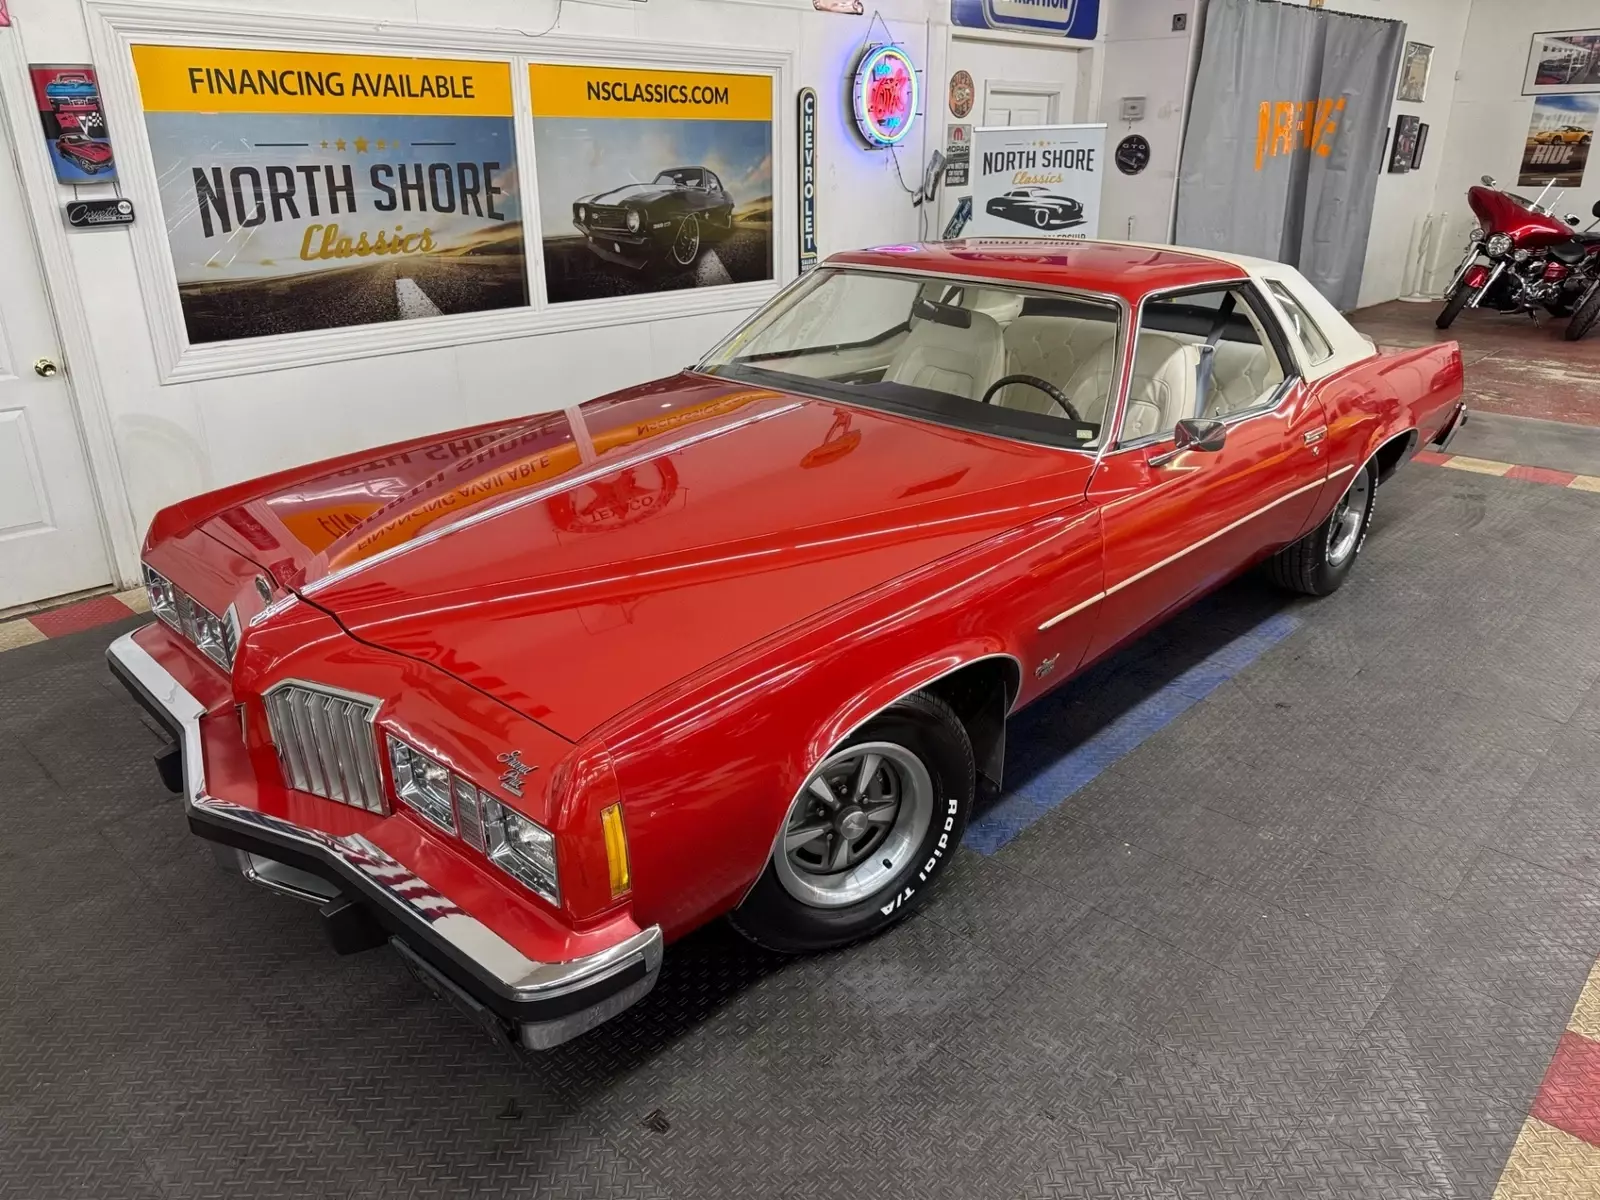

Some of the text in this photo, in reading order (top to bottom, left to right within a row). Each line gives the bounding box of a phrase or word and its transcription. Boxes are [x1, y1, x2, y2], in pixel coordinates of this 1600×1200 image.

[188, 67, 475, 99] FINANCING AVAILABLE
[586, 80, 729, 105] NSCLASSICS.COM
[982, 150, 1036, 176] NORTH
[1042, 149, 1095, 172] SHORE
[1530, 145, 1574, 165] RIDE
[804, 97, 813, 249] CHEVROLET
[1012, 171, 1063, 185] Classics
[69, 204, 119, 223] Corvette
[192, 162, 505, 238] NORTH SHORE
[300, 223, 437, 262] Classics
[880, 799, 958, 916] Radial T/A
